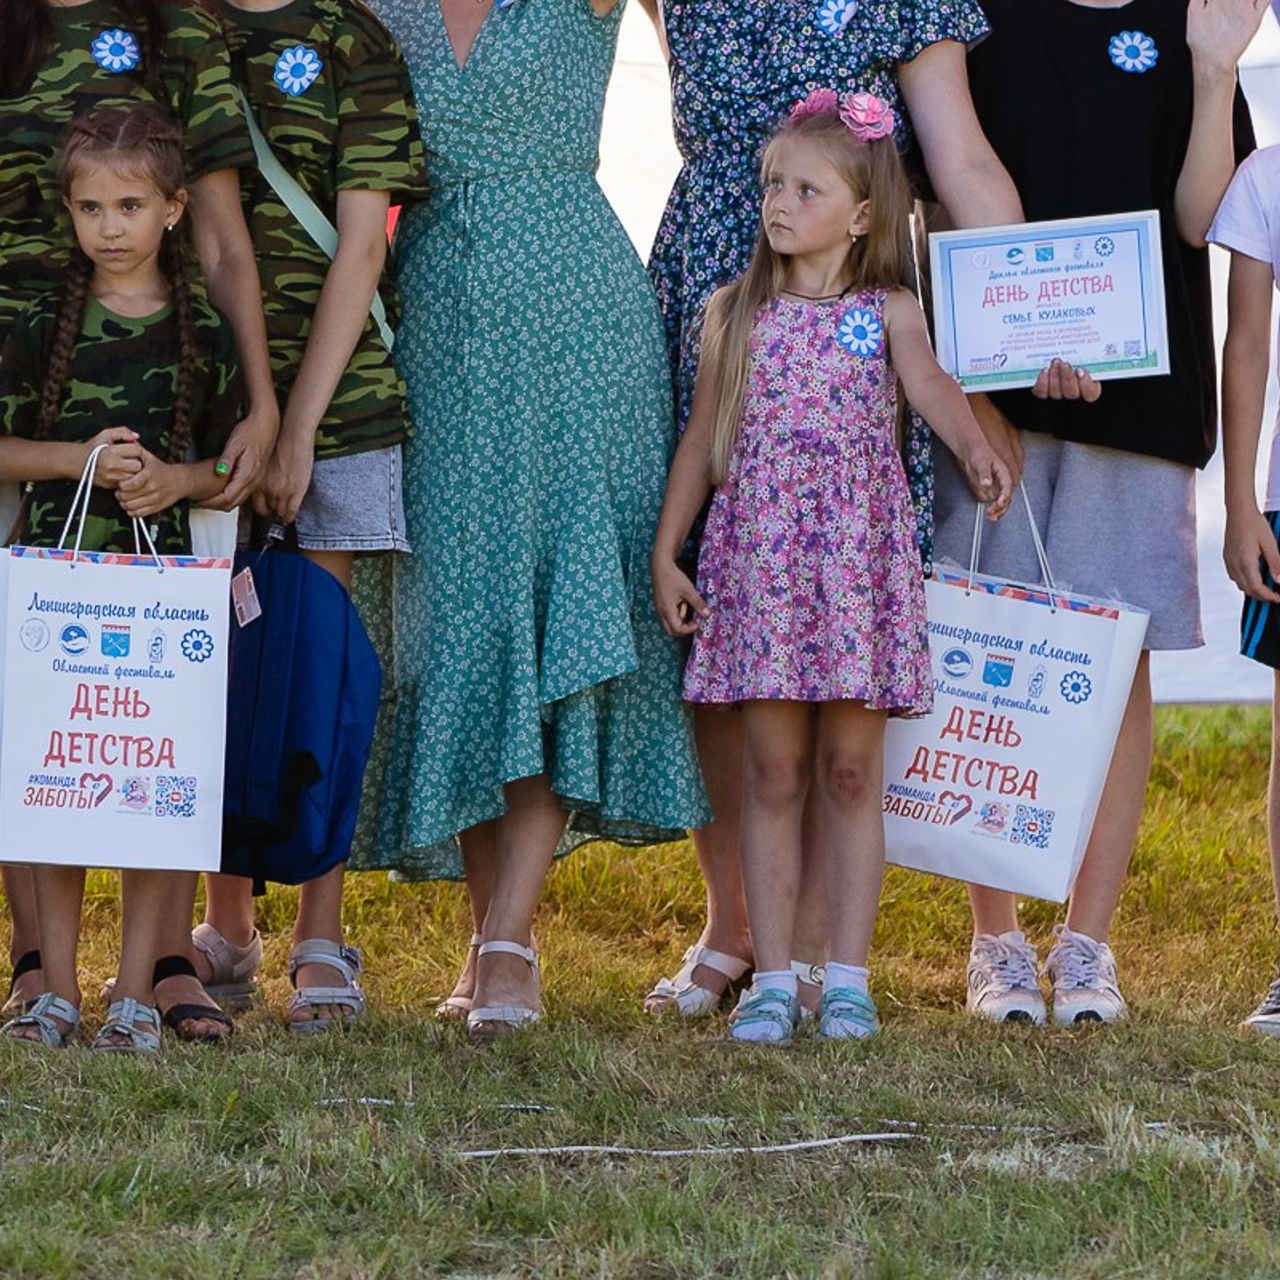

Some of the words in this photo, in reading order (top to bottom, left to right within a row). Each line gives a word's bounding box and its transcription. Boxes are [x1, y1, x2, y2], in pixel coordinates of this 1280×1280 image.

[982, 284, 1029, 308] ДЕНЬ
[1037, 274, 1114, 302] ДЕТСТВА
[1001, 312, 1032, 325] СЕМЬЕ
[27, 592, 136, 621] Ленинградская
[144, 601, 210, 621] область
[925, 620, 1024, 653] енинградская
[1029, 639, 1093, 665] область
[52, 658, 110, 676] Областной
[114, 664, 176, 680] фестиваль
[70, 682, 151, 721] ДЕНЬ
[992, 694, 1051, 715] фестиваль
[939, 705, 1023, 748] ДЕНЬ
[43, 730, 176, 769] ДЕТСТВА
[28, 773, 76, 788] #КОМАНДА
[904, 745, 1039, 800] ДЕТСТВА
[23, 786, 94, 809] ЗАБОТЫ
[886, 783, 936, 802] #КОМАНДА
[882, 794, 952, 826] ЗАБОТЫ
